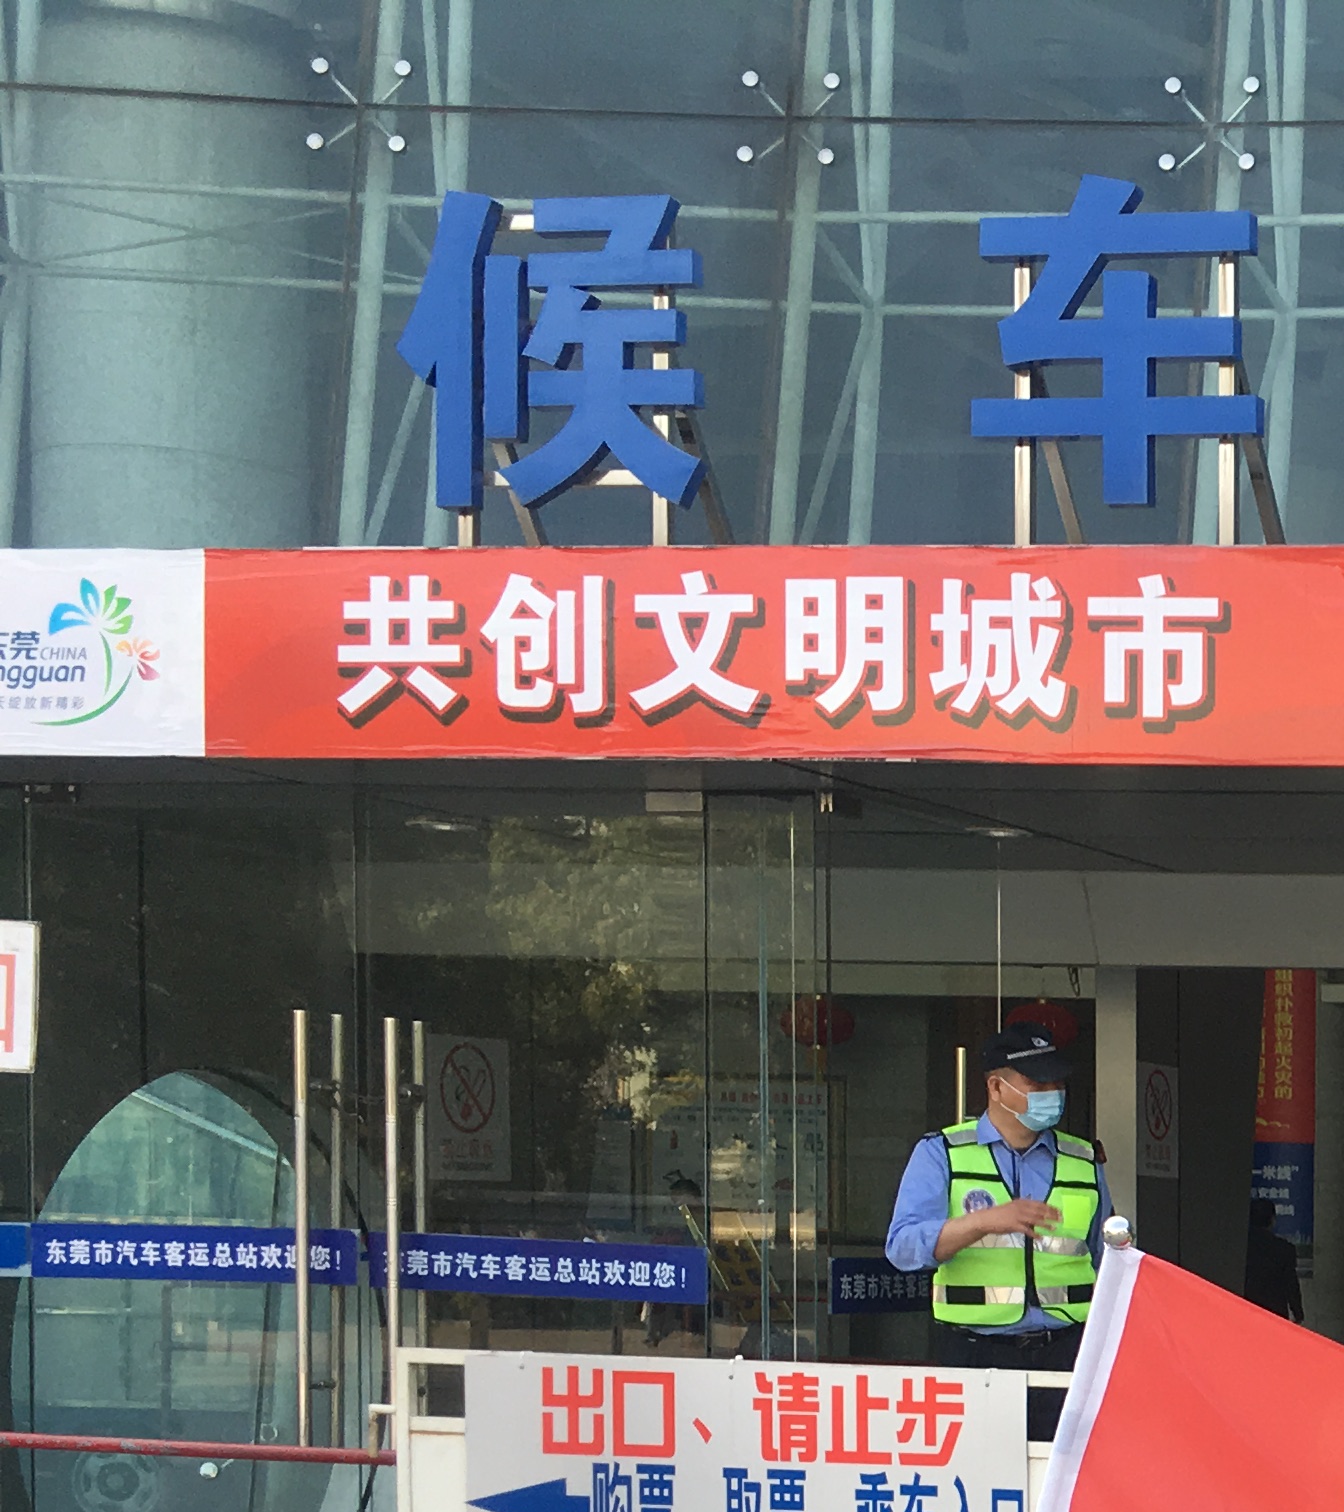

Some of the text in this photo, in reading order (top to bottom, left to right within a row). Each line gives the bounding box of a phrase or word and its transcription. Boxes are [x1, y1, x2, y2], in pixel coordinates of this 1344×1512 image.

[40, 647, 88, 661] CHINA
[337, 568, 1222, 727] 共创文明城市
[0, 697, 85, 710] 绽放新精彩
[542, 1366, 965, 1467] 出口、请止步
